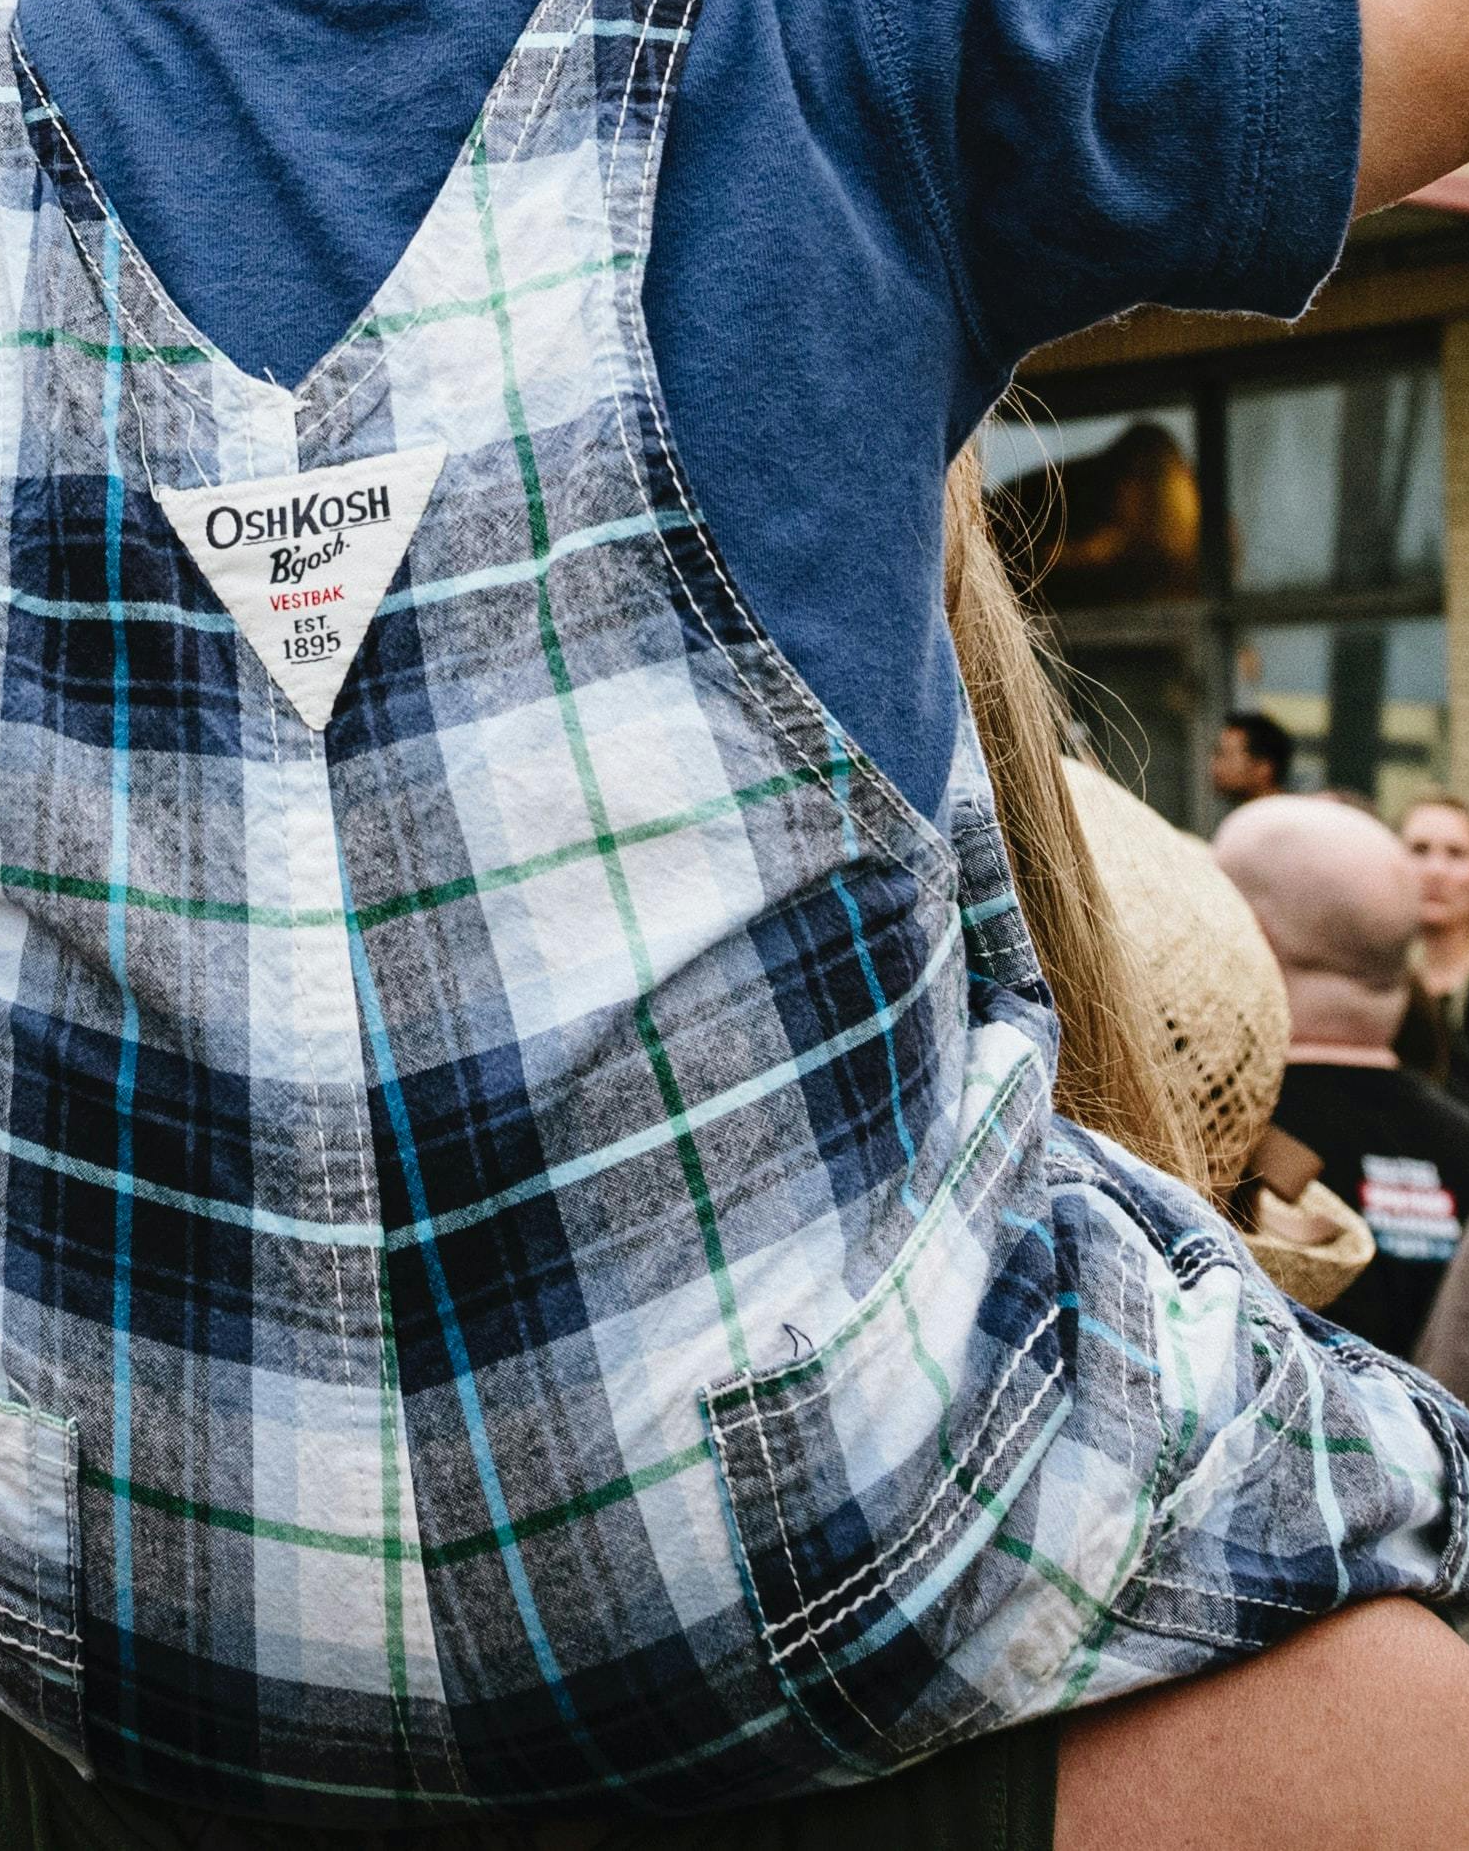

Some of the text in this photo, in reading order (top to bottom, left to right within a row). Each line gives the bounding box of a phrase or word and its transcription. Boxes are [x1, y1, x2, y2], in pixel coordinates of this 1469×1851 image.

[269, 584, 345, 612] VESTBAK
[293, 614, 331, 635] EST.
[281, 630, 342, 661] 1895
